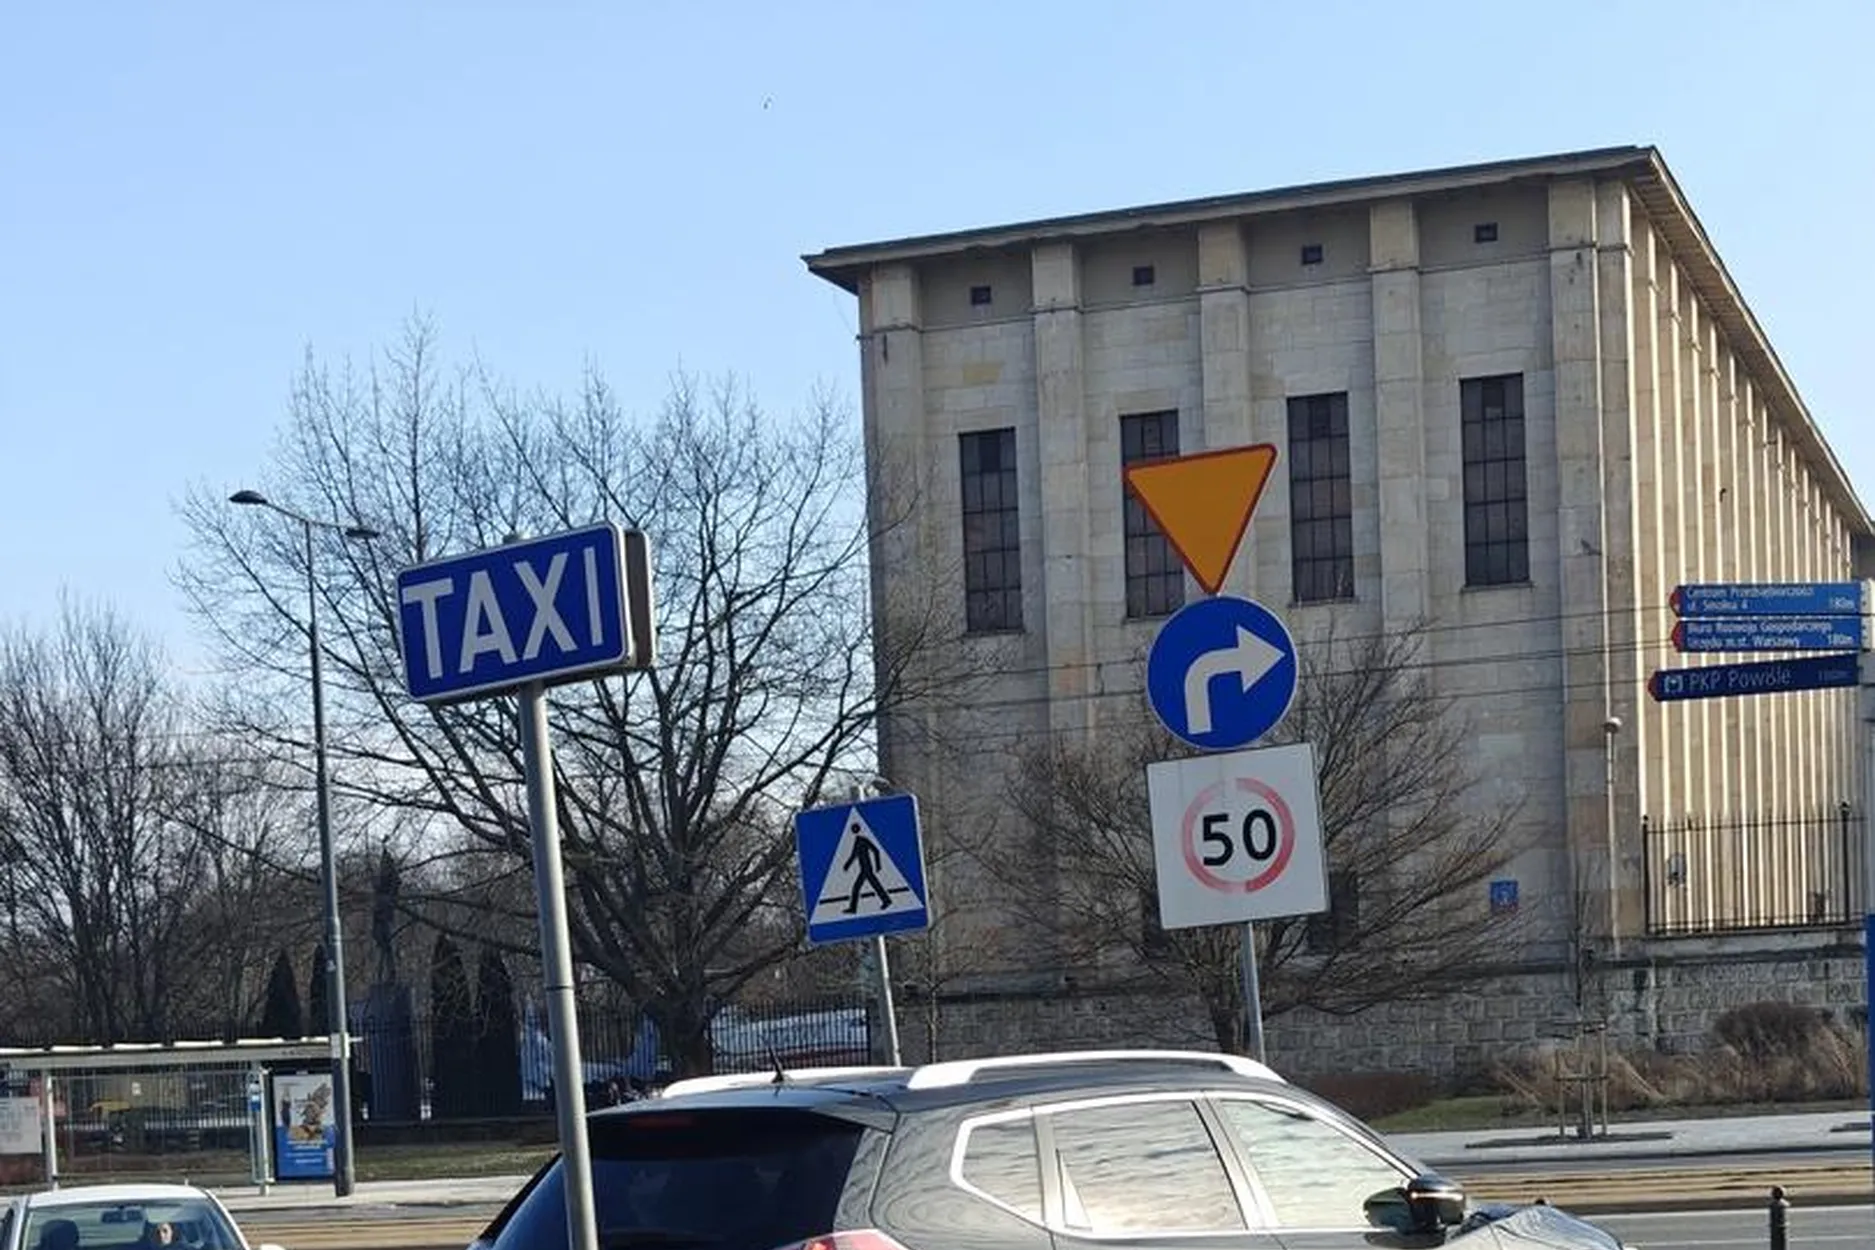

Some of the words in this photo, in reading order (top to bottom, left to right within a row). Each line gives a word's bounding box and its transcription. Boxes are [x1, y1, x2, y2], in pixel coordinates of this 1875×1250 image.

[402, 546, 604, 680] TAXI
[1689, 669, 1721, 692] PKP
[1203, 809, 1276, 866] 50
